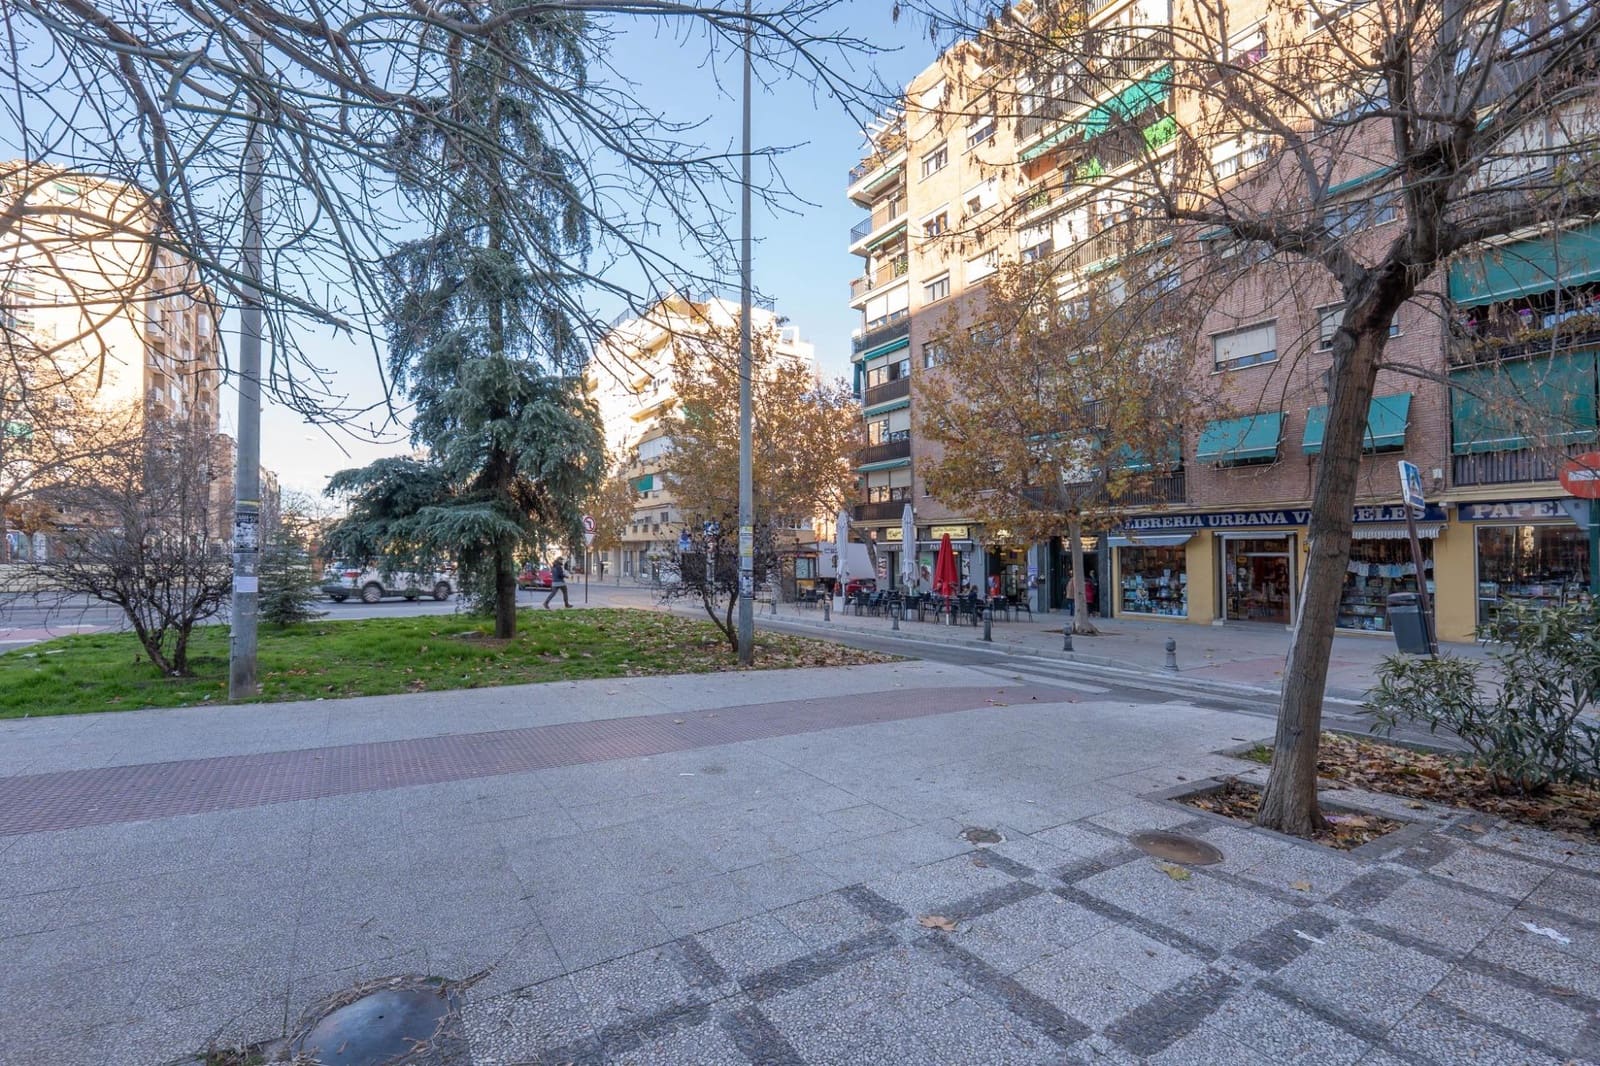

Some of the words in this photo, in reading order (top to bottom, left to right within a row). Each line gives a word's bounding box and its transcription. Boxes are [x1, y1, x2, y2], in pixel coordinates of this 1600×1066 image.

[1125, 515, 1204, 530] LIBRERIA
[1208, 511, 1289, 527] URBANA
[1291, 506, 1426, 524] VELES
